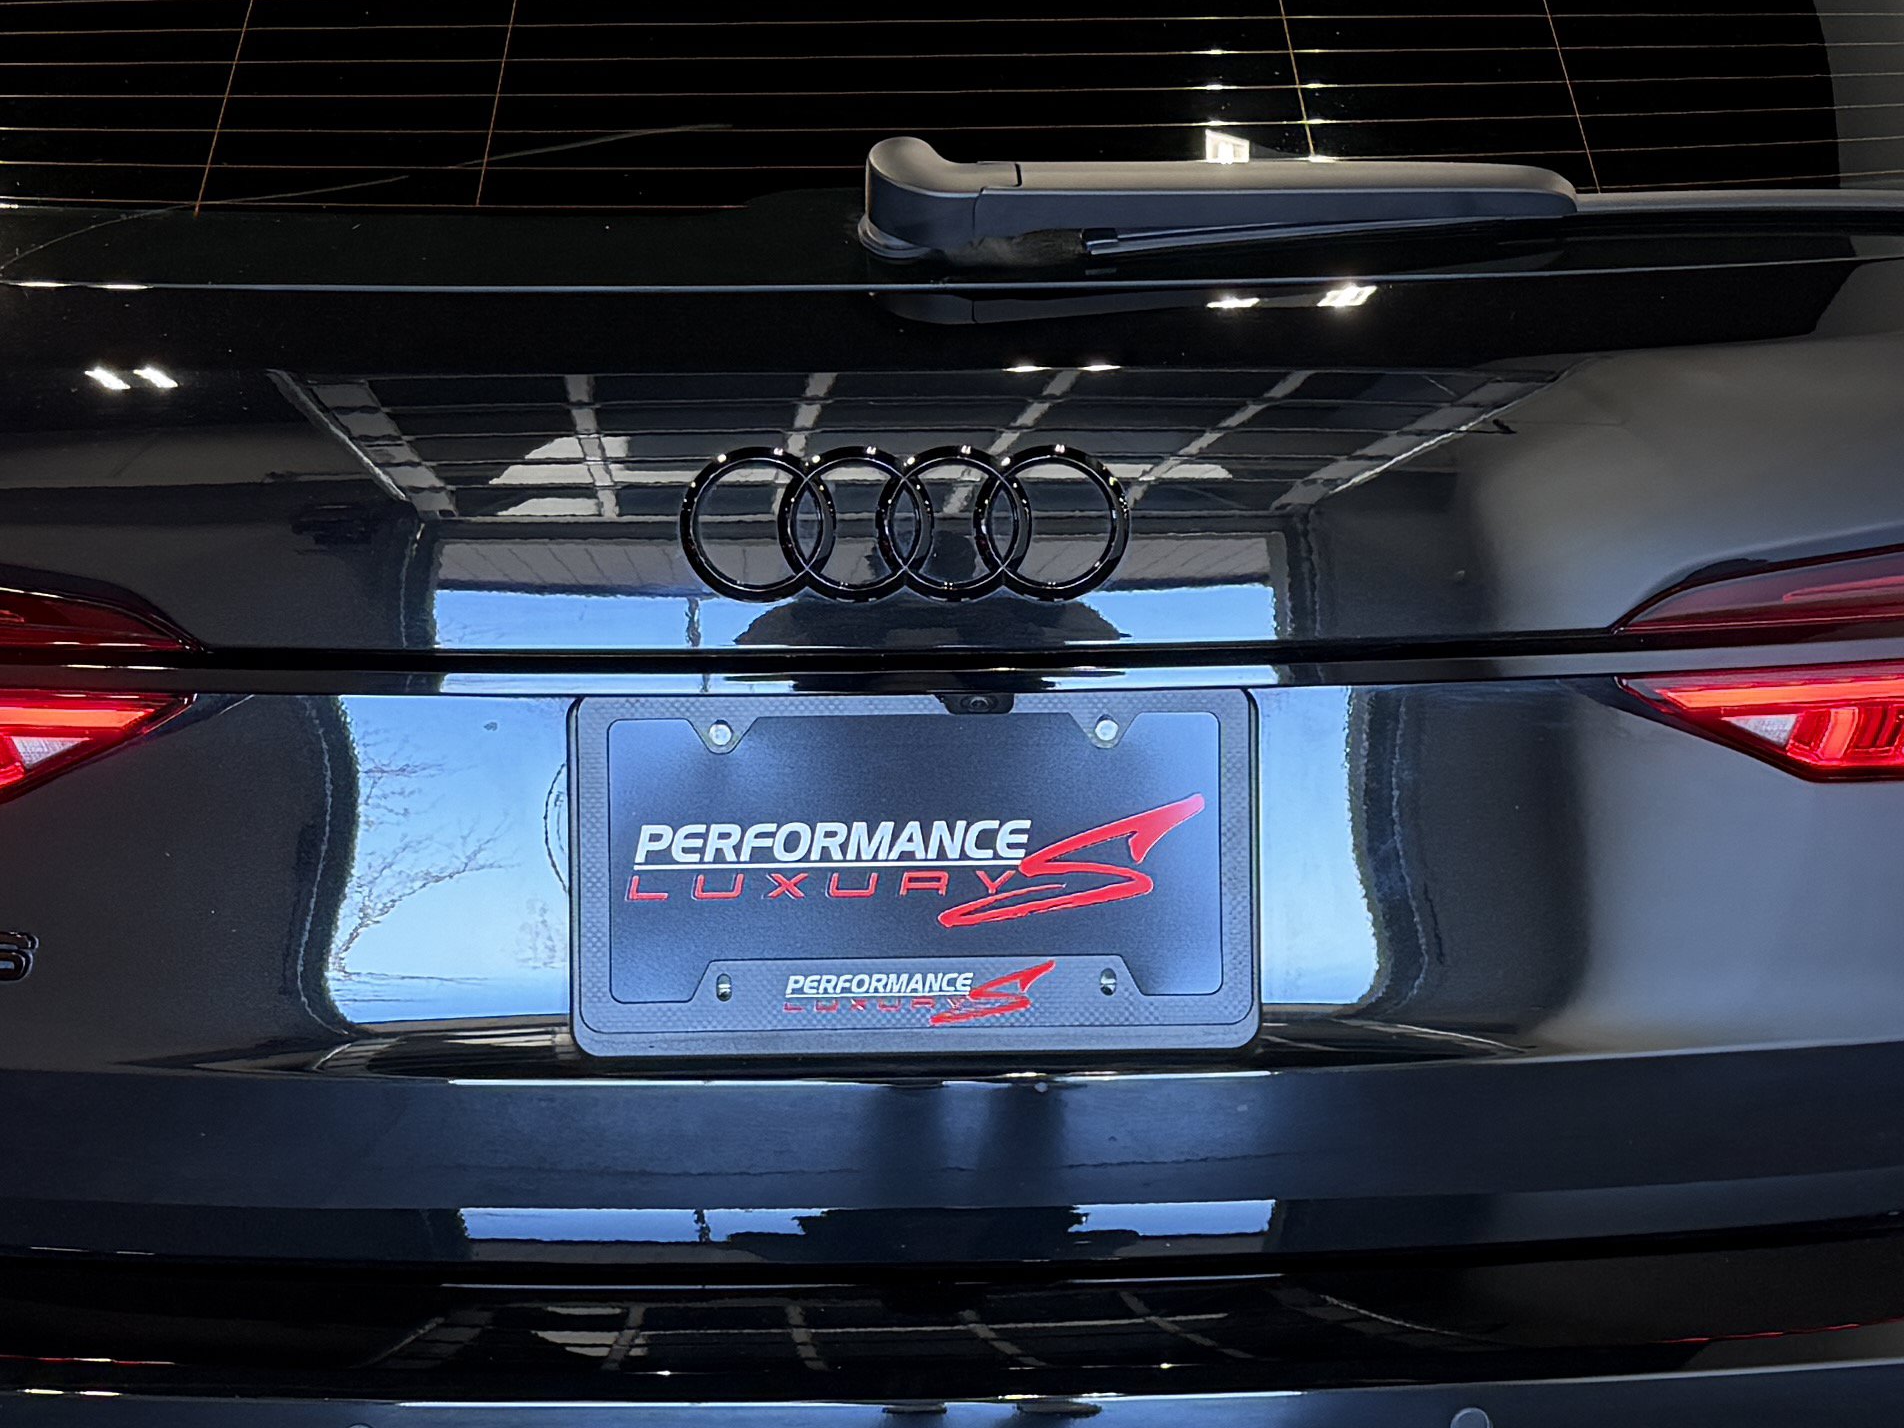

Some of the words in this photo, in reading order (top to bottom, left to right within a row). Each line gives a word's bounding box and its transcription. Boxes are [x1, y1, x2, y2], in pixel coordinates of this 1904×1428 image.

[634, 819, 1032, 863] PERFORMANCE
[626, 870, 1015, 901] LUXURY
[785, 972, 974, 994] PERFORMANCE
